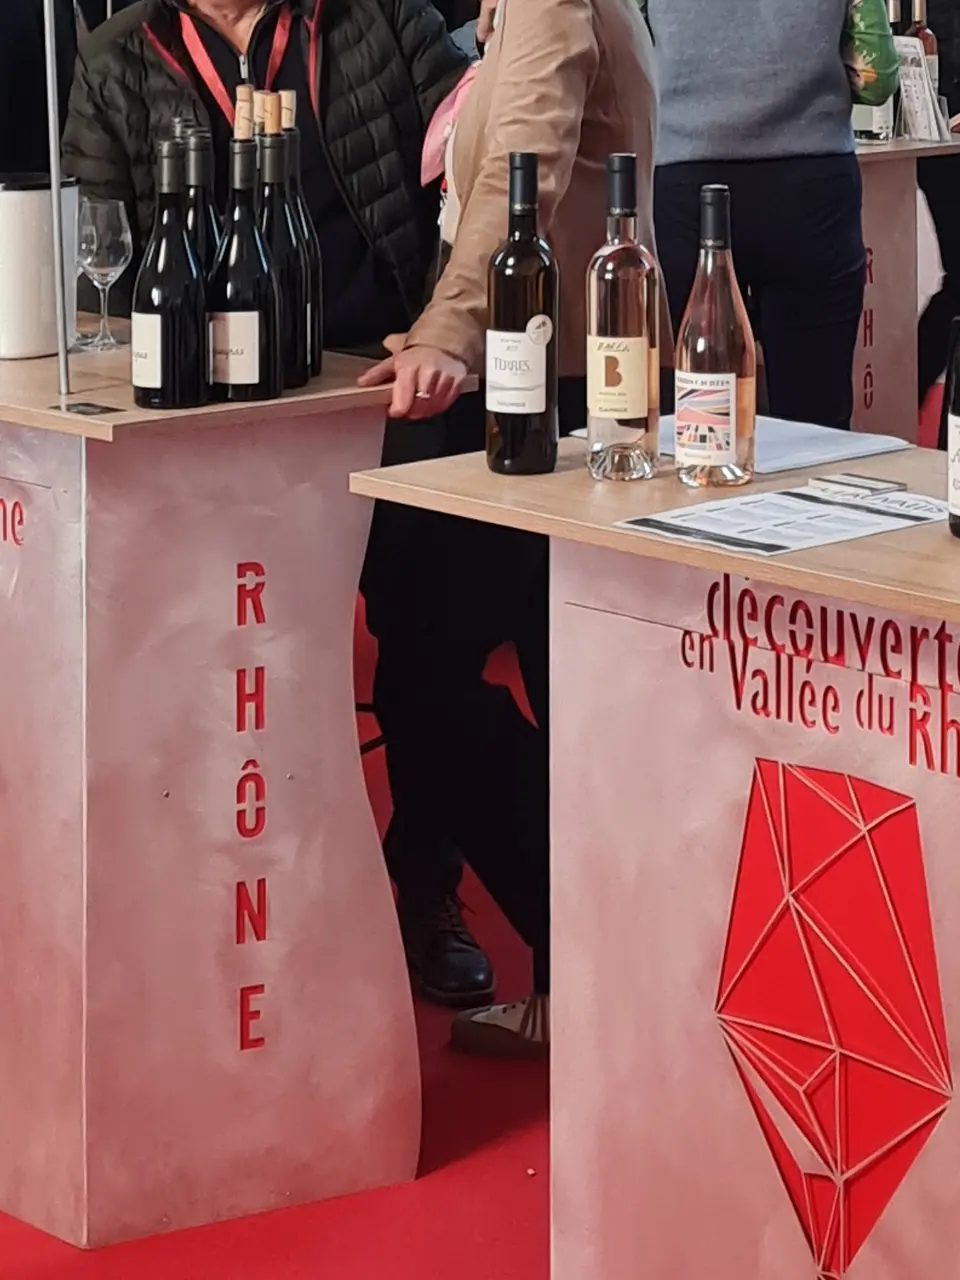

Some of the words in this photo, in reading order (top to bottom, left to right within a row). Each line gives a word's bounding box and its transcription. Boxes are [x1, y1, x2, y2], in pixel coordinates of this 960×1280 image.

[604, 355, 623, 388] B
[681, 630, 715, 674] en
[727, 638, 840, 735] Vallée
[855, 672, 895, 736] du
[235, 561, 267, 1052] RHÔNE
